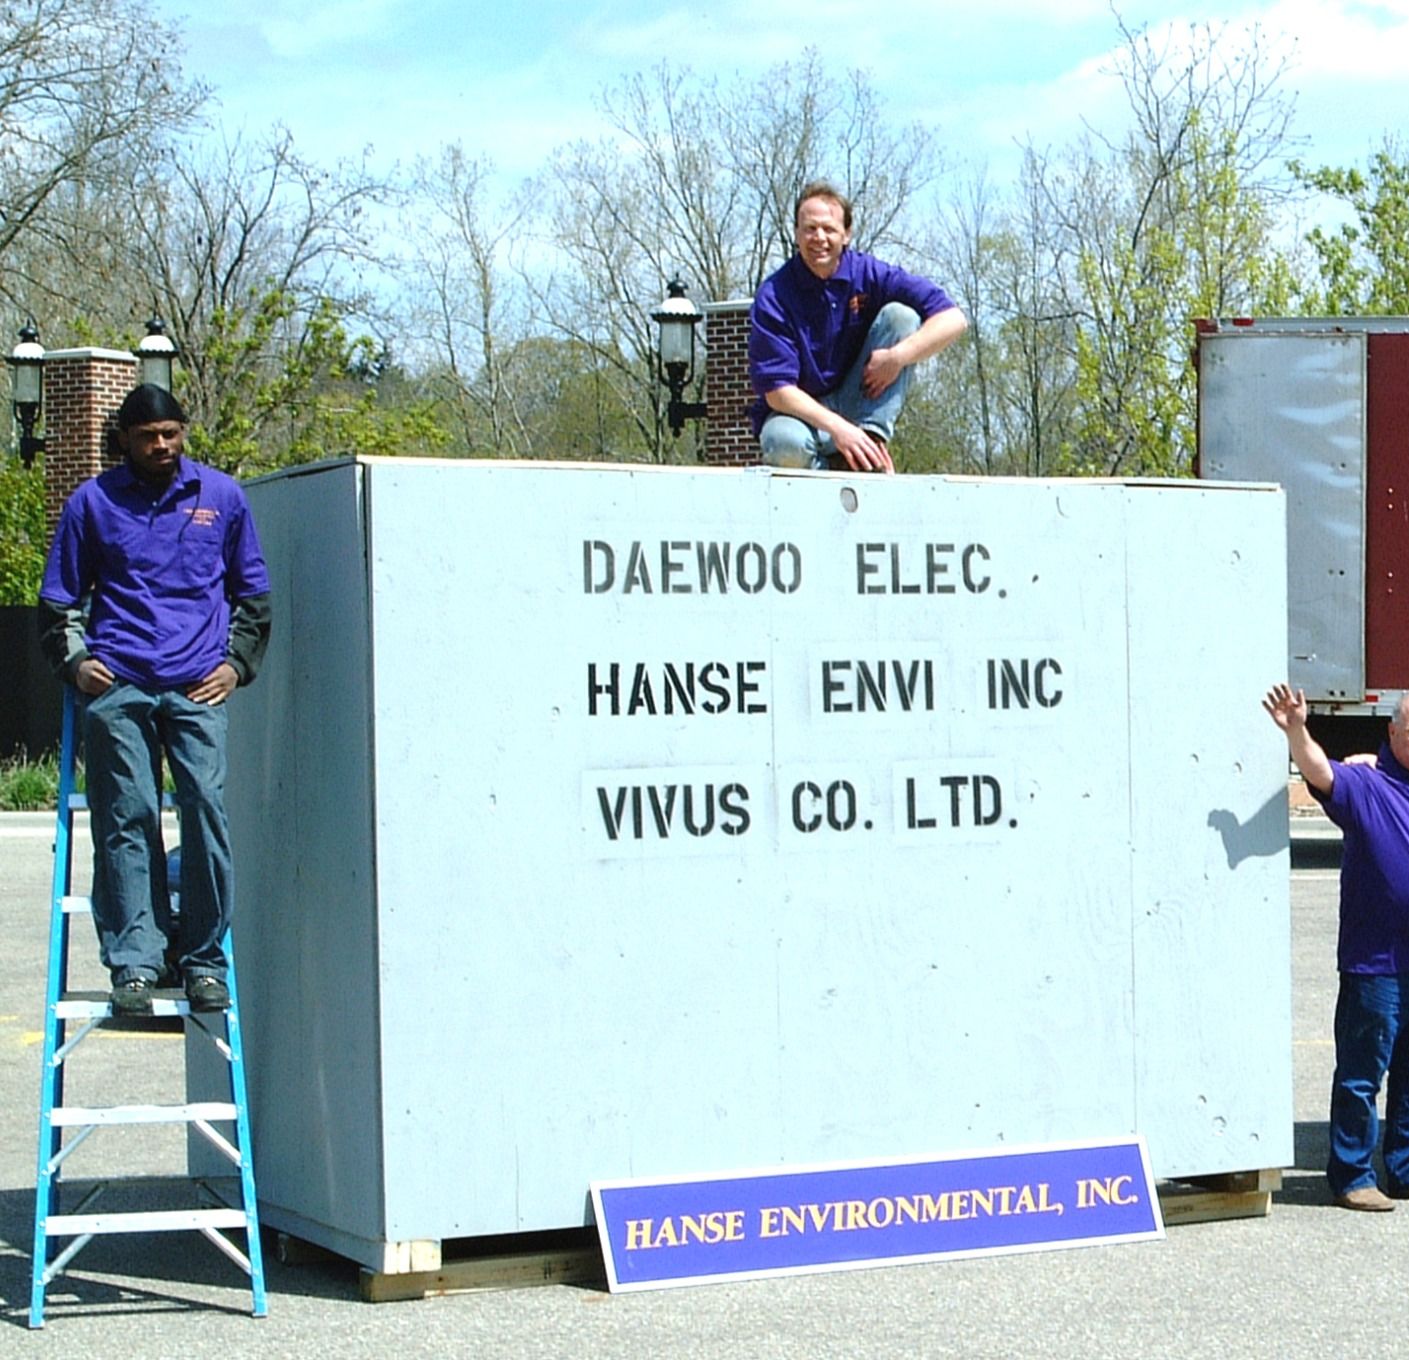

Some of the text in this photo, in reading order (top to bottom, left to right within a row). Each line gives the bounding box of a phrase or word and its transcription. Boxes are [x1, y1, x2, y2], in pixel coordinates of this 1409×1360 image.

[582, 540, 1007, 598] DAEWOO ELEC.
[587, 658, 1064, 716] HANSE ENVI INC
[597, 775, 1018, 841] VIVUS CO. LTD.
[625, 1174, 1139, 1251] HANSE ENVIRONMENTAL, INC.
